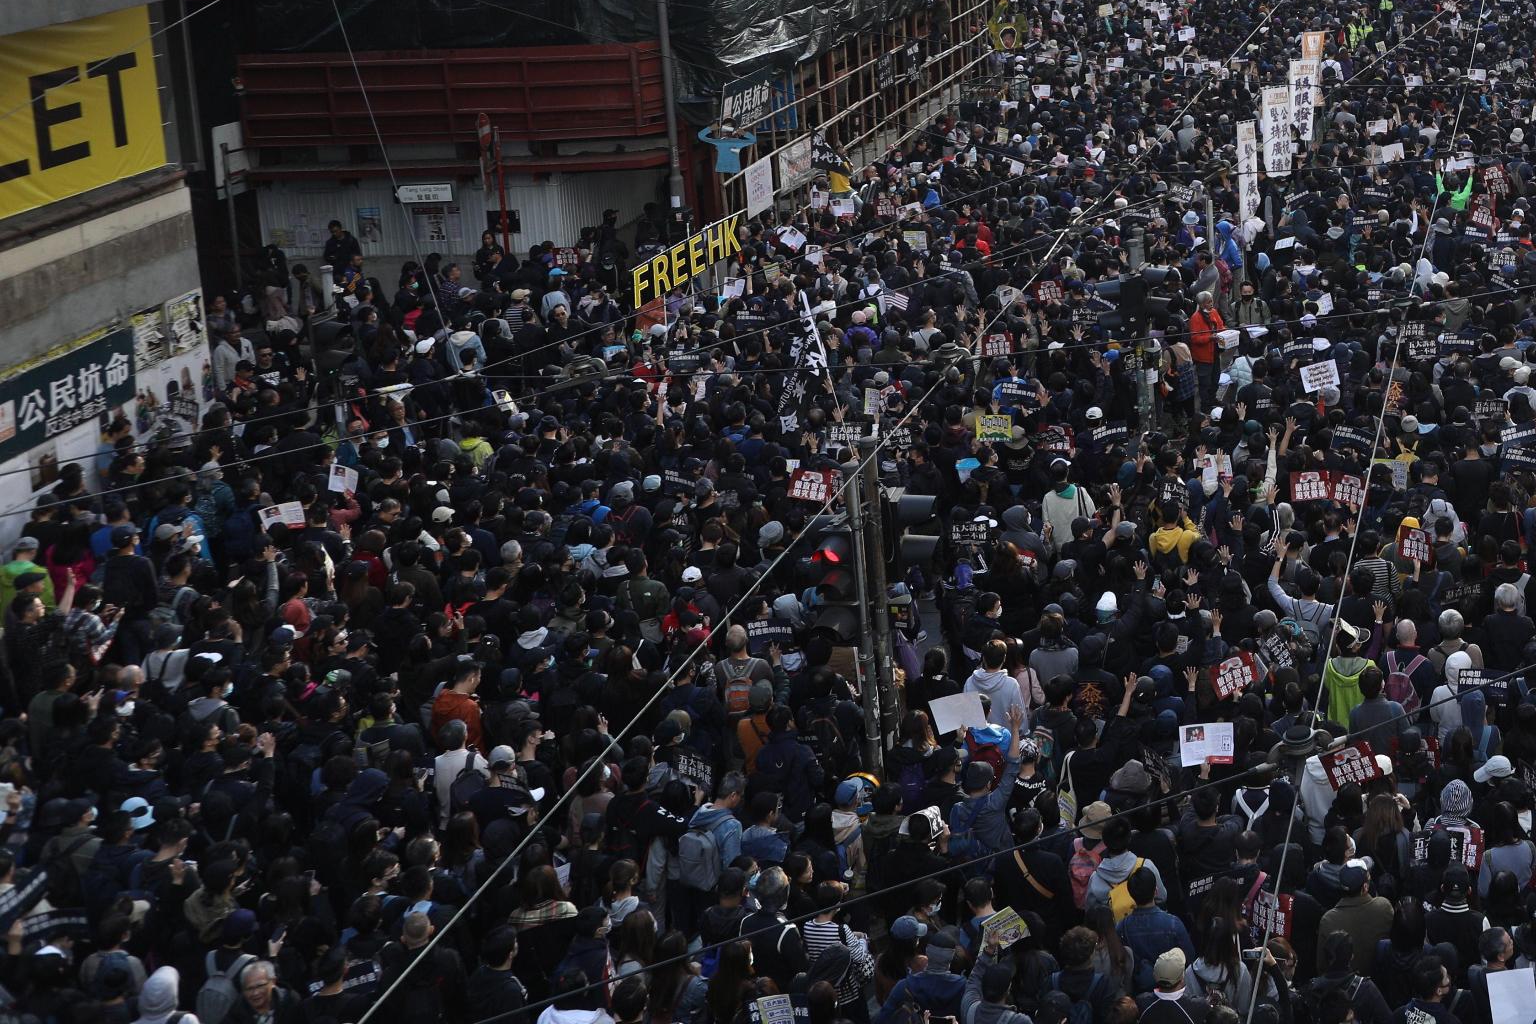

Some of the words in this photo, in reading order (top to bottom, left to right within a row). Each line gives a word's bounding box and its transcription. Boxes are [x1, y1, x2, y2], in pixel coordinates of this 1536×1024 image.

[732, 78, 770, 119] 公民抗命
[19, 351, 131, 431] 公民抗命
